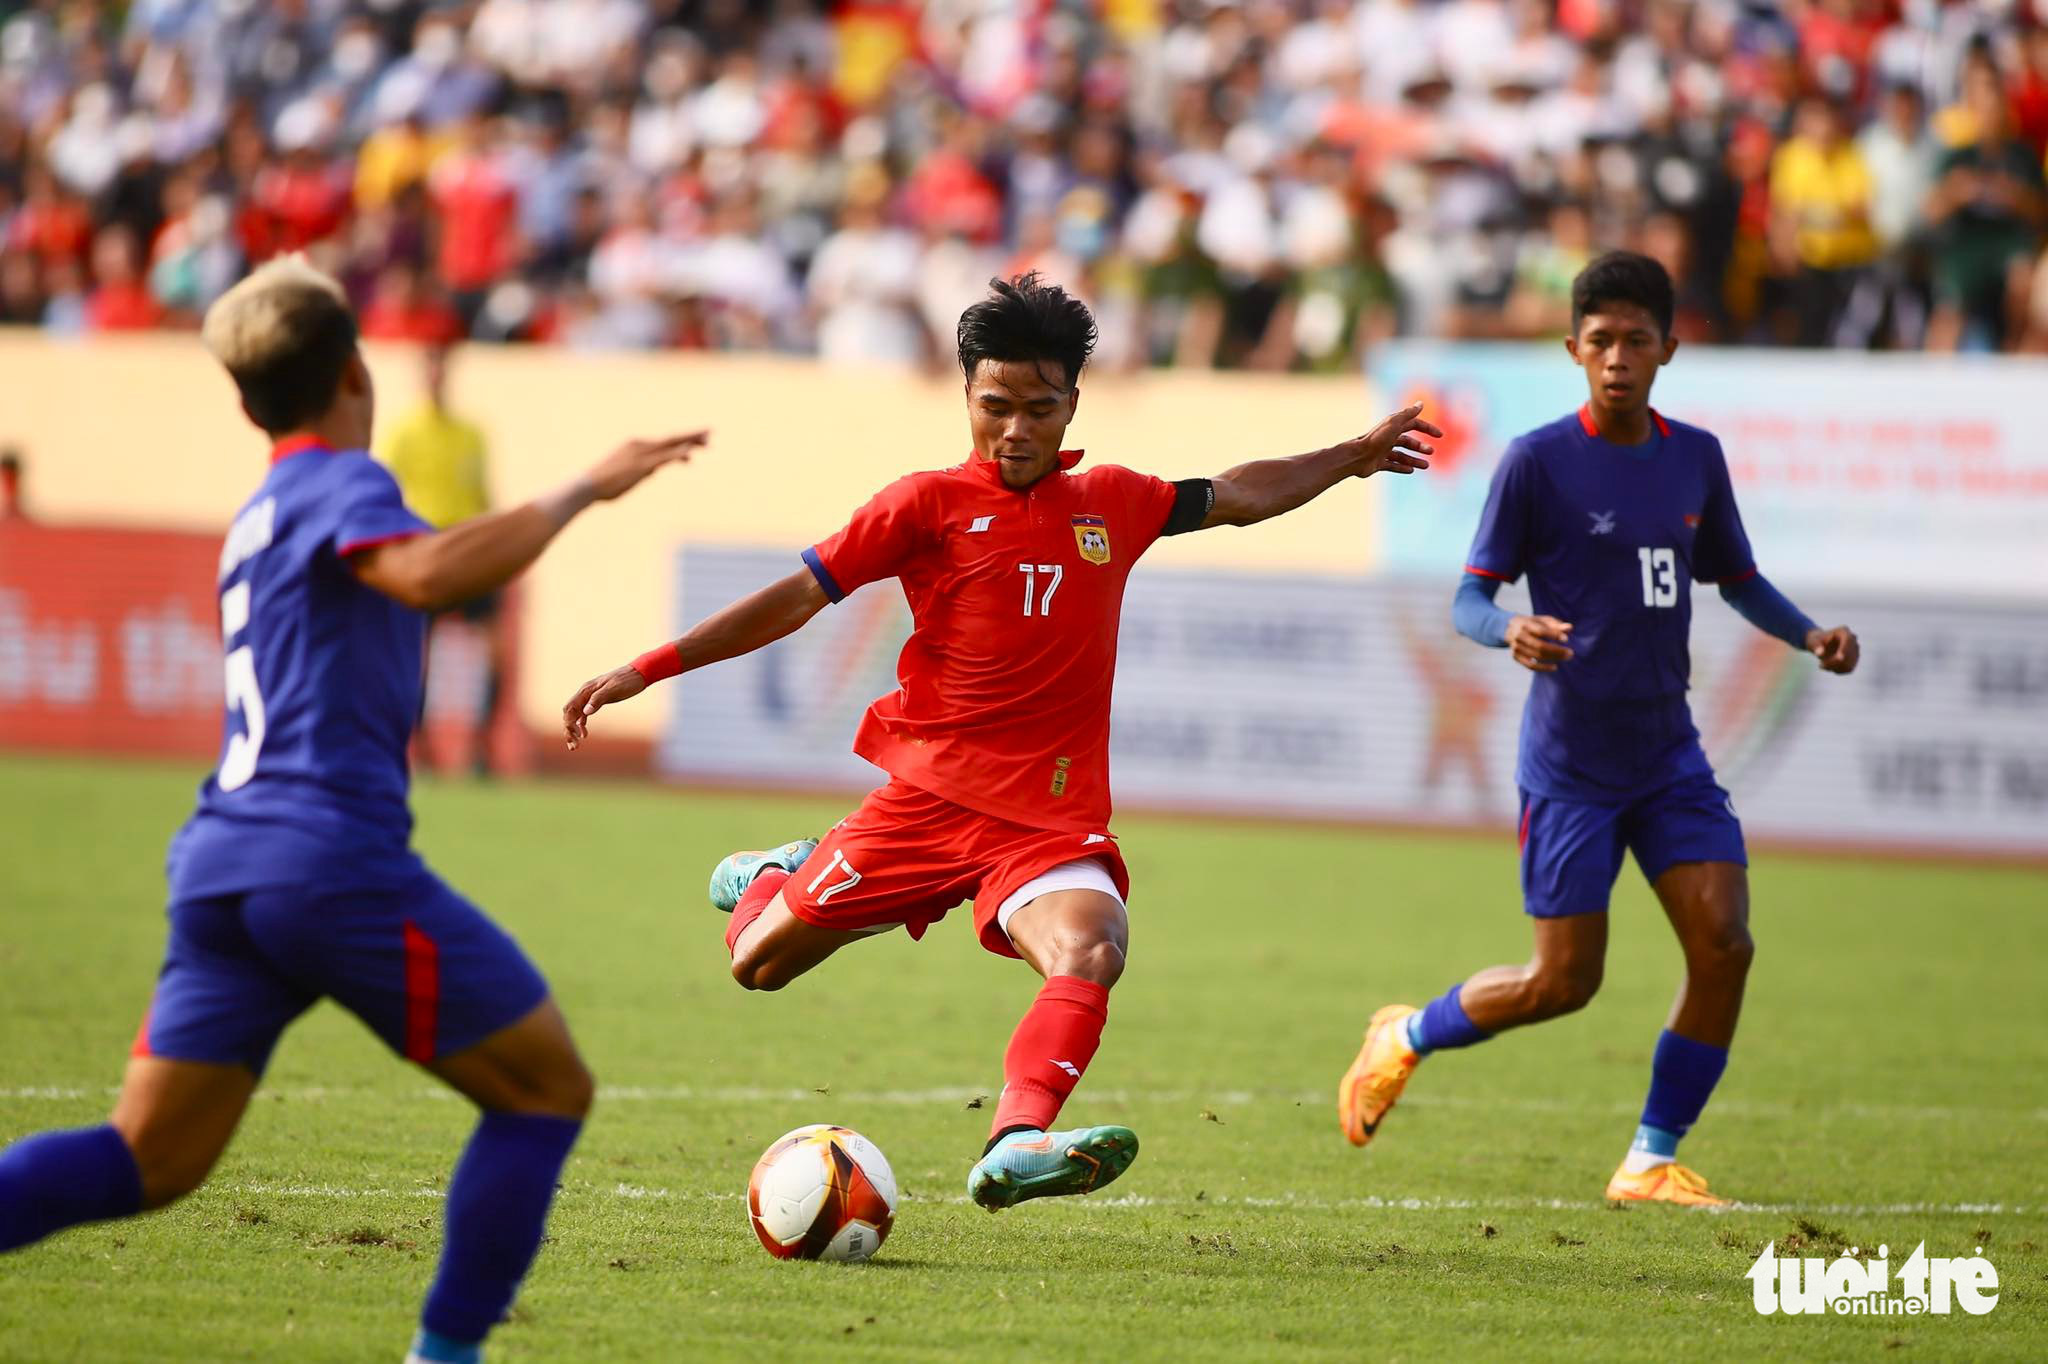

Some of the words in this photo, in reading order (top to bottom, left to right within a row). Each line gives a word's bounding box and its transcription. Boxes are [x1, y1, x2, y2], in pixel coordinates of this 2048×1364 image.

[1019, 563, 1063, 616] 17
[1638, 547, 1677, 607] 13
[218, 580, 265, 792] 5
[807, 848, 862, 906] 17
